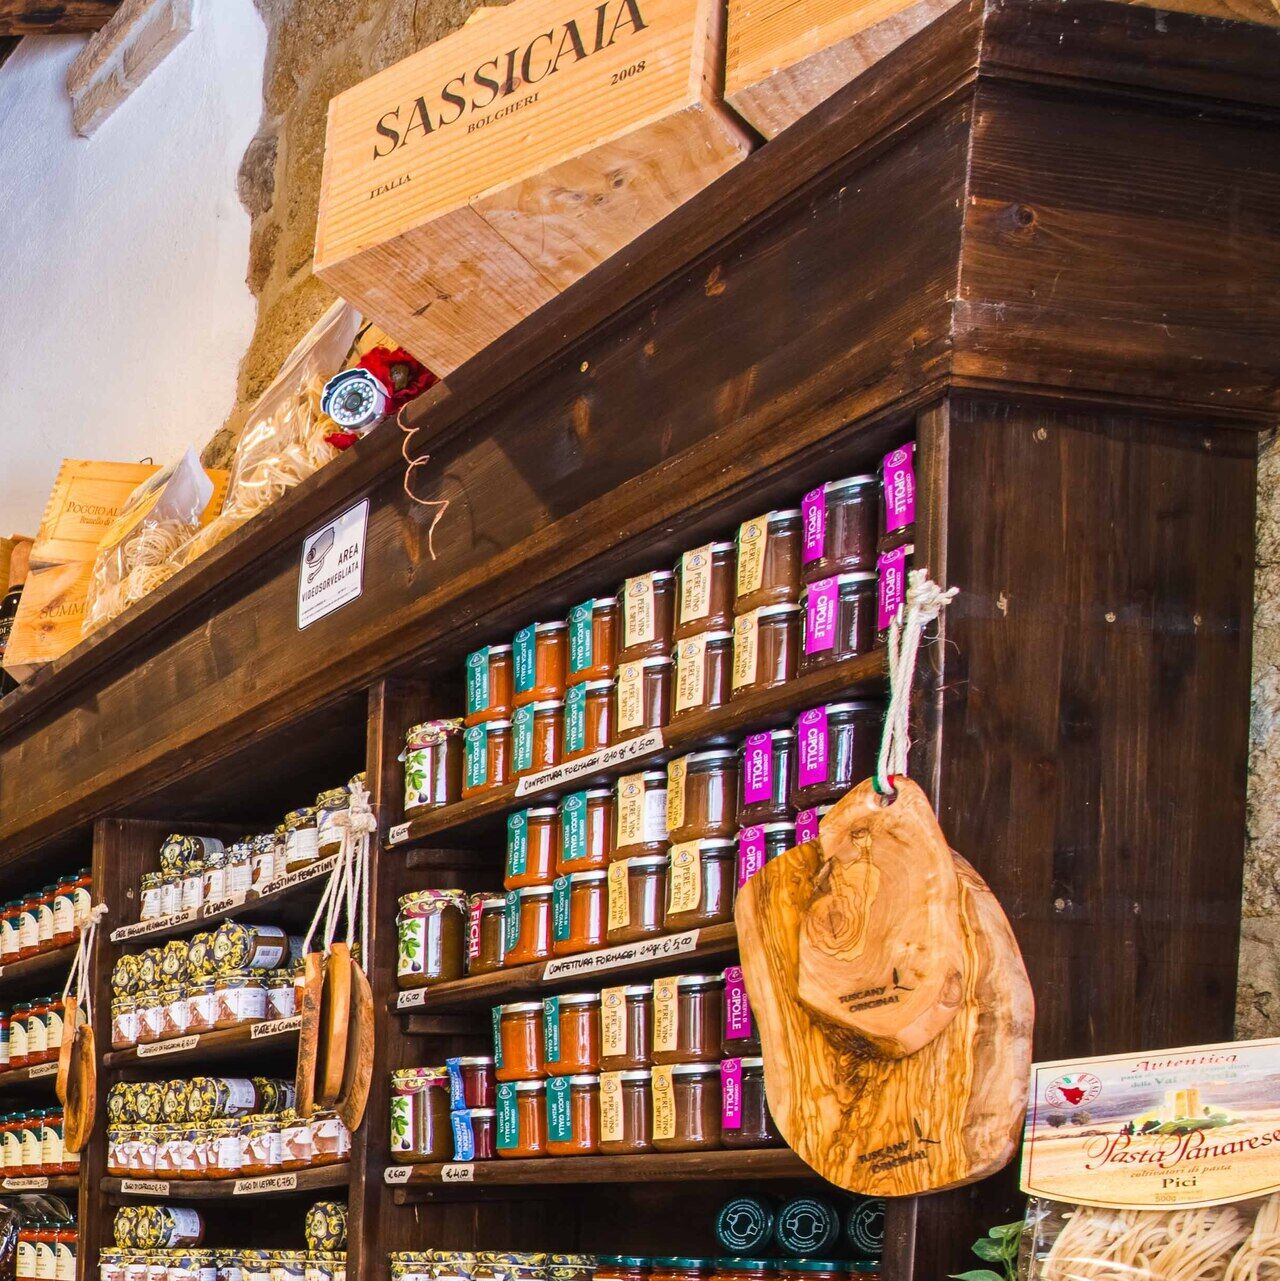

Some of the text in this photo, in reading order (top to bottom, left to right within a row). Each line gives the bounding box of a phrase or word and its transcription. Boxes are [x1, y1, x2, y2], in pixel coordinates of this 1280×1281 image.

[373, 0, 649, 161] SASSICAIA
[609, 59, 647, 87] 2008
[466, 92, 540, 135] BOLGHERI
[369, 173, 412, 200] ITALIA
[66, 500, 103, 517] POGGIO
[893, 469, 907, 515] CIPOLLE
[806, 504, 818, 548] CIPOLLE
[338, 543, 359, 566] AREA
[302, 561, 359, 602] VIDEOSORVEGLIATA
[884, 567, 900, 614] CIPOLLE
[814, 594, 835, 638] CIPOLLE
[752, 745, 770, 790] CIPOLLE
[806, 729, 820, 772] CIPOLLE
[524, 770, 564, 791] CONFETTURA
[564, 755, 601, 778] FORMAGGI
[470, 908, 480, 960] FICHI
[549, 956, 594, 975] CONFETTURA
[595, 948, 638, 965] FORMAGGI
[731, 988, 742, 1031] CIPOLLE
[838, 985, 888, 1005] TUSCANY
[848, 995, 900, 1014] ORIGINAL
[1131, 1053, 1239, 1073] Autentica
[725, 1078, 735, 1118] CIPOLLE
[1083, 1128, 1166, 1171] Pasta
[1130, 1163, 1233, 1179] cultivatori di pasta
[1161, 1175, 1198, 1189] Pici
